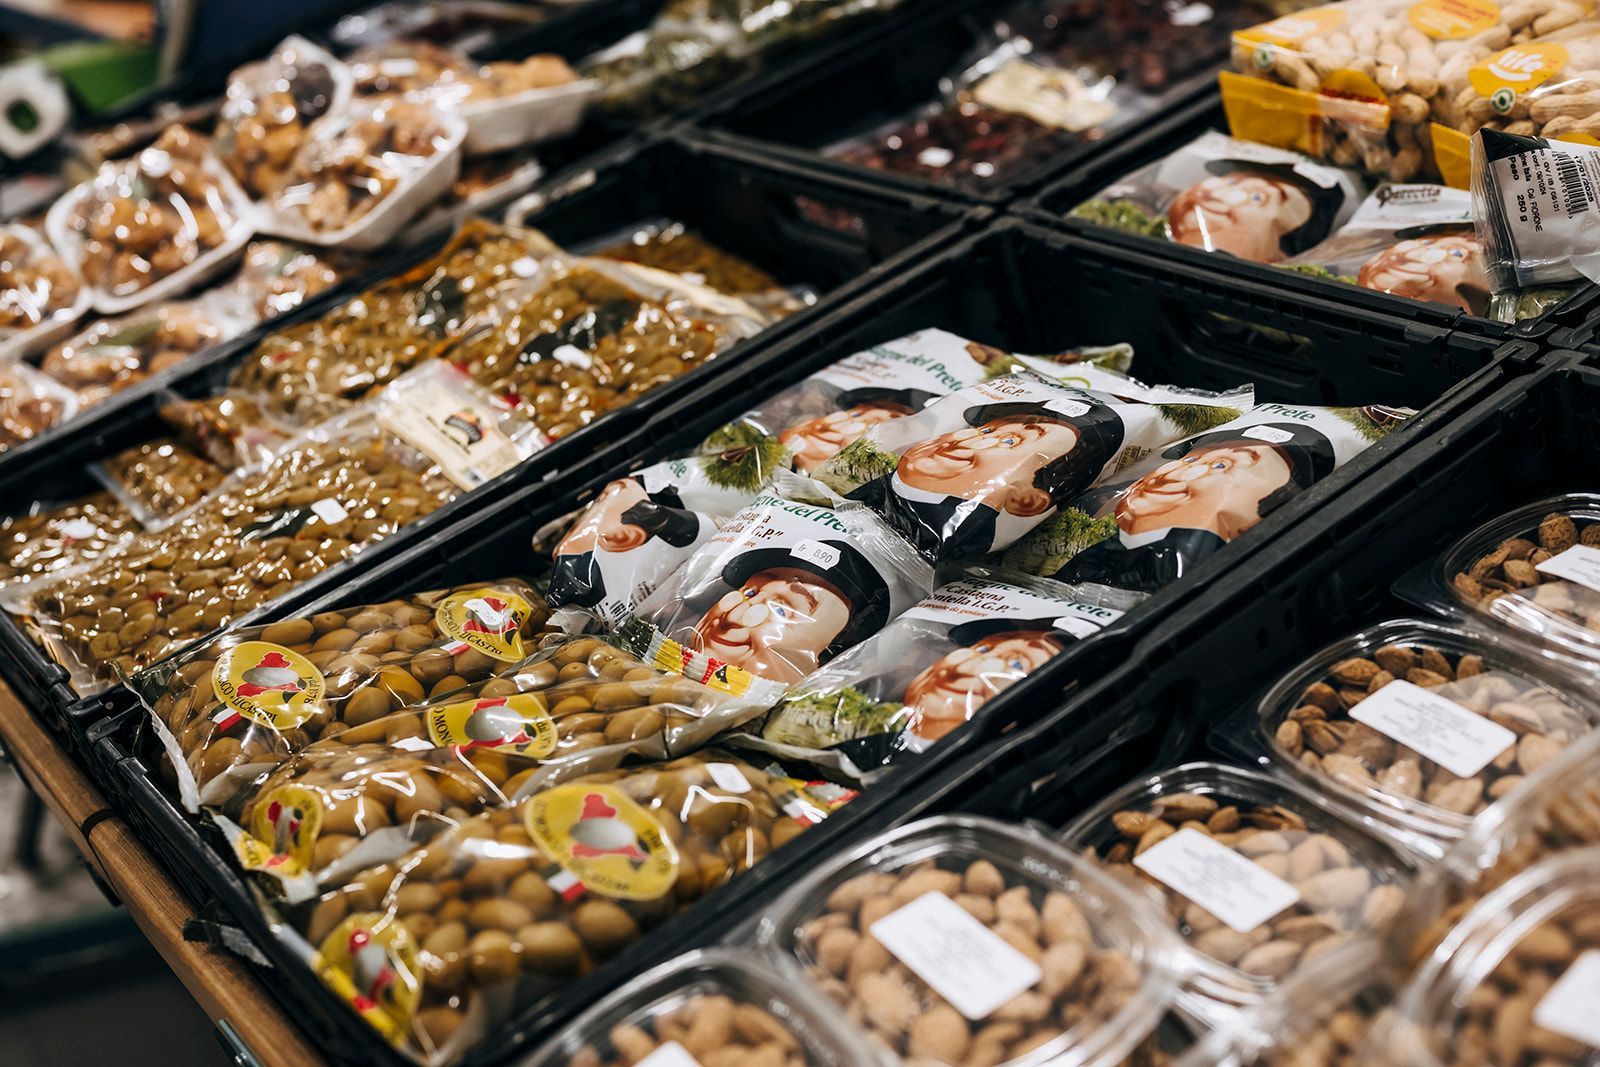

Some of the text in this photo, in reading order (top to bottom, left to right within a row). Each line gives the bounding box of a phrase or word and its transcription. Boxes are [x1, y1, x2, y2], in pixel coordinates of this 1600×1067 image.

[1498, 50, 1544, 73] life
[1508, 156, 1519, 181] Peso
[1517, 194, 1527, 213] 250
[1261, 404, 1317, 422] Prete
[783, 505, 819, 519] del
